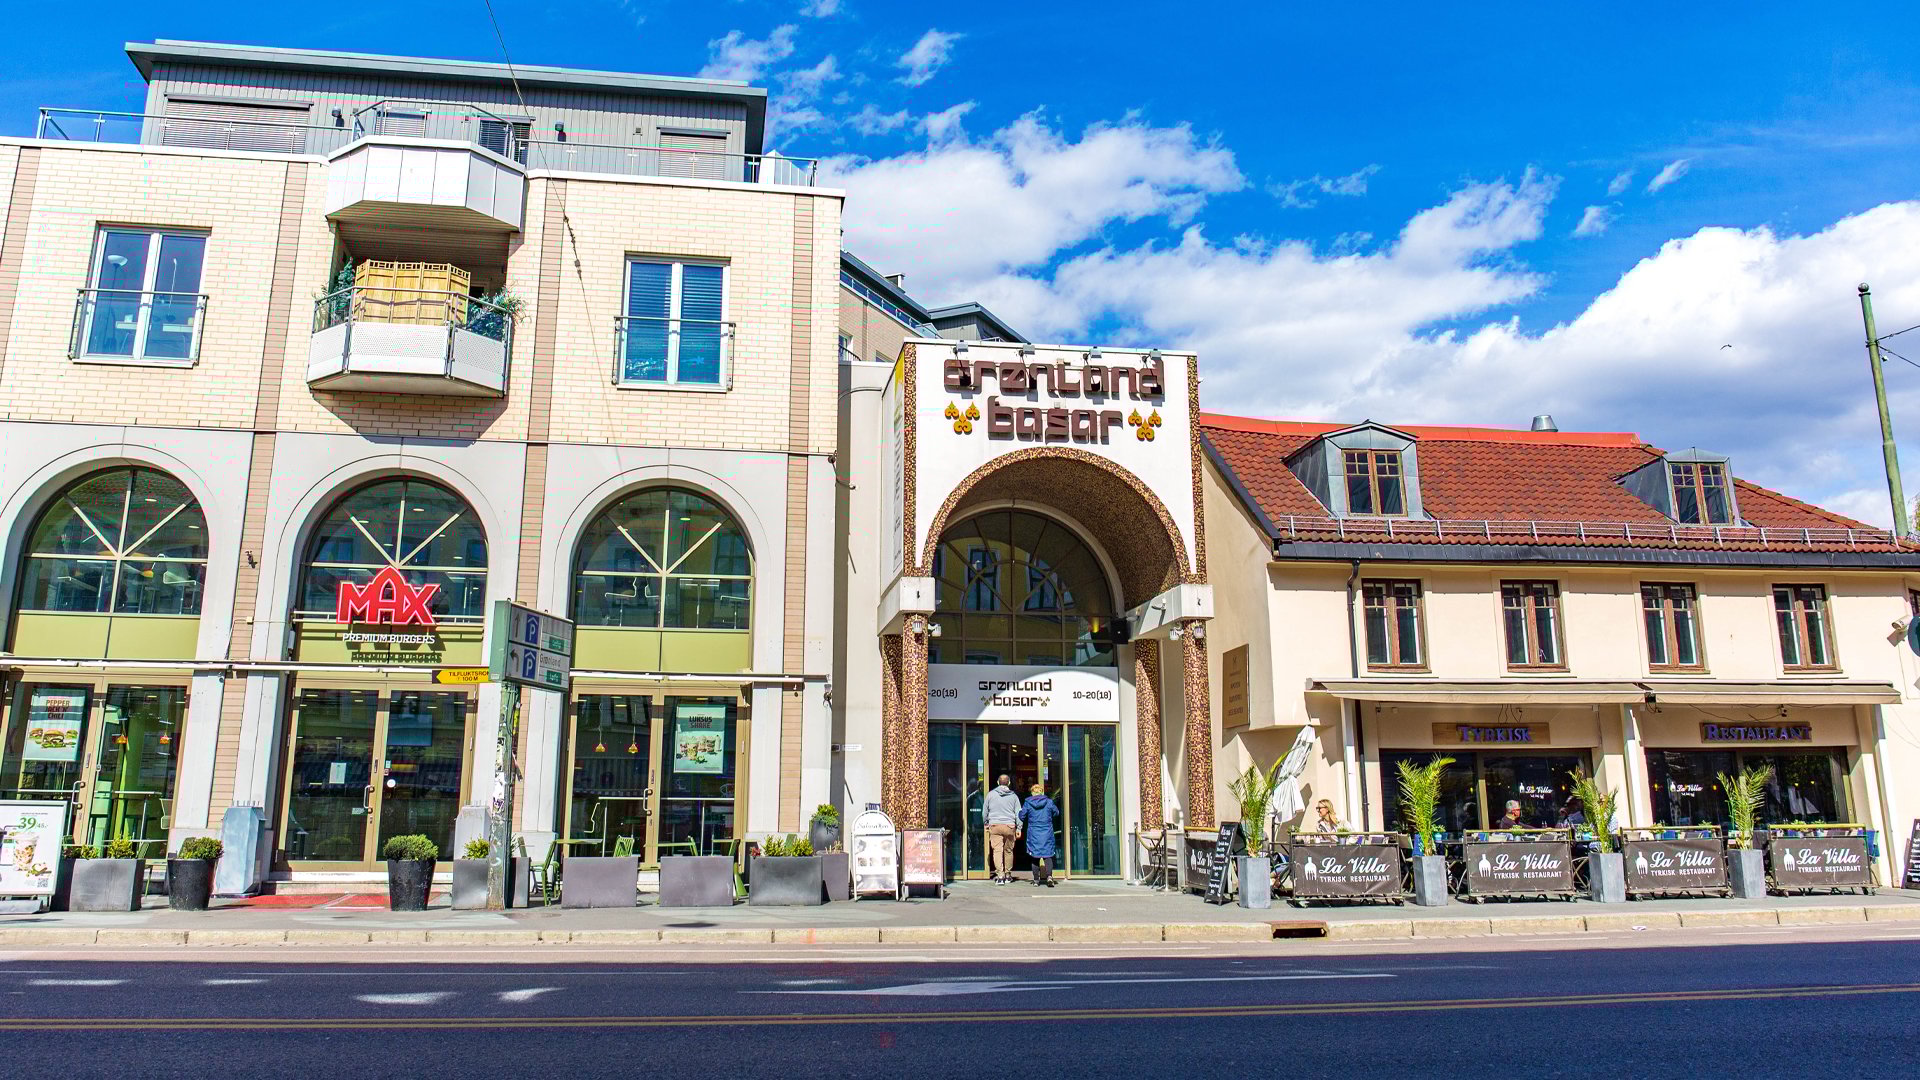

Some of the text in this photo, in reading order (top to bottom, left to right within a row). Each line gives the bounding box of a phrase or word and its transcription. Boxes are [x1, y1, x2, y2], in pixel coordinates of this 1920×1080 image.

[944, 358, 1164, 397] Grønland
[988, 396, 1123, 441] basar
[337, 565, 440, 624] MAX
[342, 632, 435, 644] PREMIUM BURGERS
[928, 689, 958, 699] -20(18)
[978, 679, 1052, 692] Grønland
[993, 694, 1038, 707] basar
[1072, 691, 1112, 701] 10-20(18)
[18, 816, 36, 830] 39
[1493, 854, 1561, 871] La Villa
[1650, 851, 1715, 868] La Villa
[1796, 848, 1859, 865] La Villa
[1319, 857, 1390, 874] La Villa
